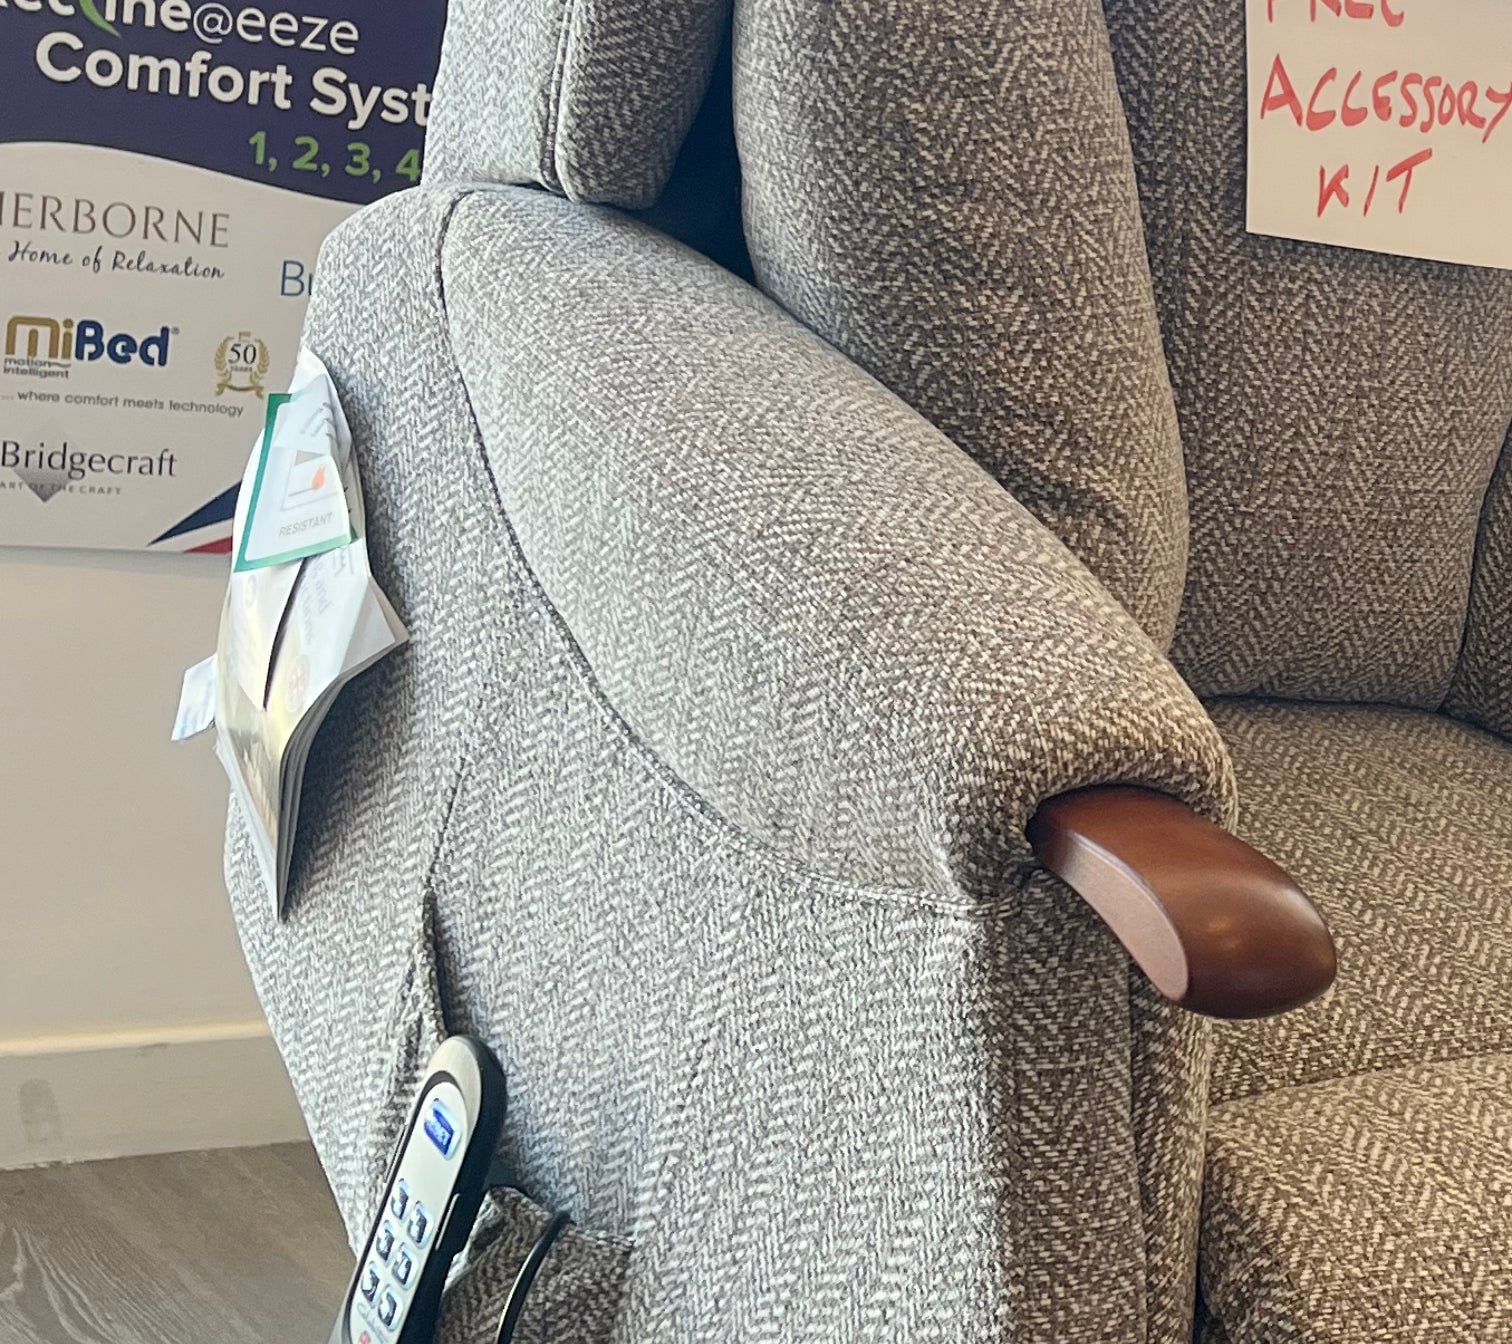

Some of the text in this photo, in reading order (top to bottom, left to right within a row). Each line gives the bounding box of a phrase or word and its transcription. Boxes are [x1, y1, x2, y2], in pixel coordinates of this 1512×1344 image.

[36, 30, 292, 109] Comfort
[248, 131, 277, 171] 1,
[293, 136, 330, 176] 2,
[345, 142, 381, 183] 3,
[1318, 148, 1433, 218] KIT
[8, 240, 224, 278] Home of Relaxation
[228, 343, 256, 364] 50
[3, 368, 69, 379] intelligent
[18, 391, 243, 417] where comfort meets technology
[1, 440, 177, 480] Bridgecraft
[79, 486, 121, 495] CRAFT
[278, 511, 334, 538] RESISTANT
